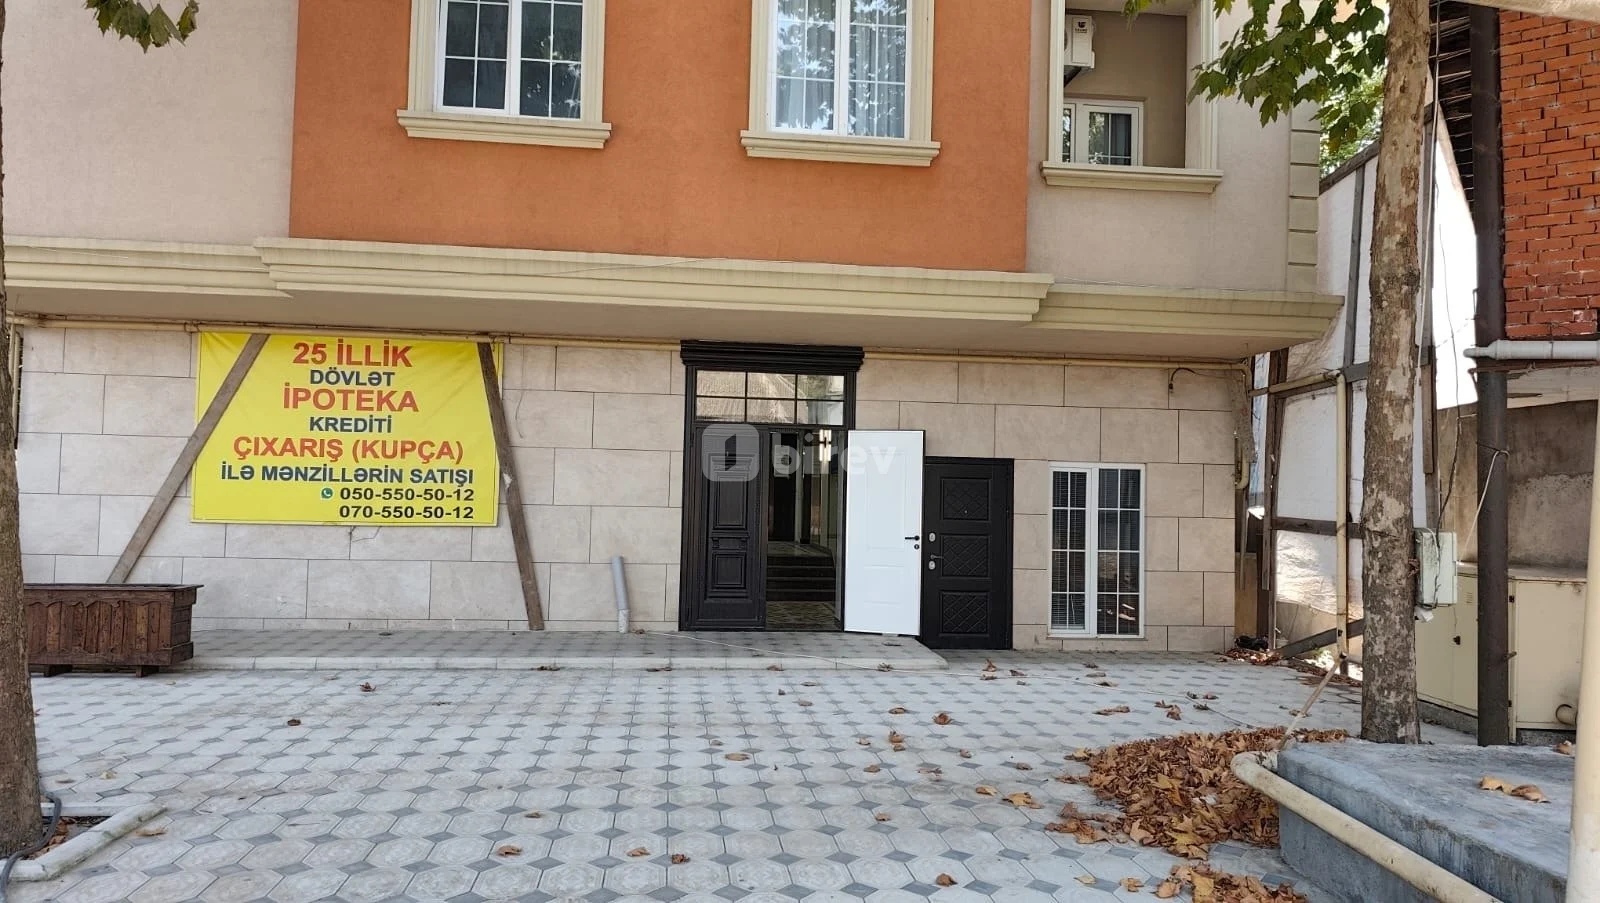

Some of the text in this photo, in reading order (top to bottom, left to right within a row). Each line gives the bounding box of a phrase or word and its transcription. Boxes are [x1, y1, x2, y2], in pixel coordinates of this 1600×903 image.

[293, 338, 412, 367] 25 İLLİK
[309, 367, 395, 386] DÖVLƏT
[283, 382, 419, 412] İPOTEKA
[309, 415, 392, 433] KREDİTİ
[233, 436, 463, 464] ÇIXARIŞ (KUPÇA)
[221, 461, 473, 487] İLƏ MƏNZİLLƏRİN SATIŞI
[340, 488, 474, 501] 050-550-50-12
[339, 505, 474, 519] 070-550-50-12
